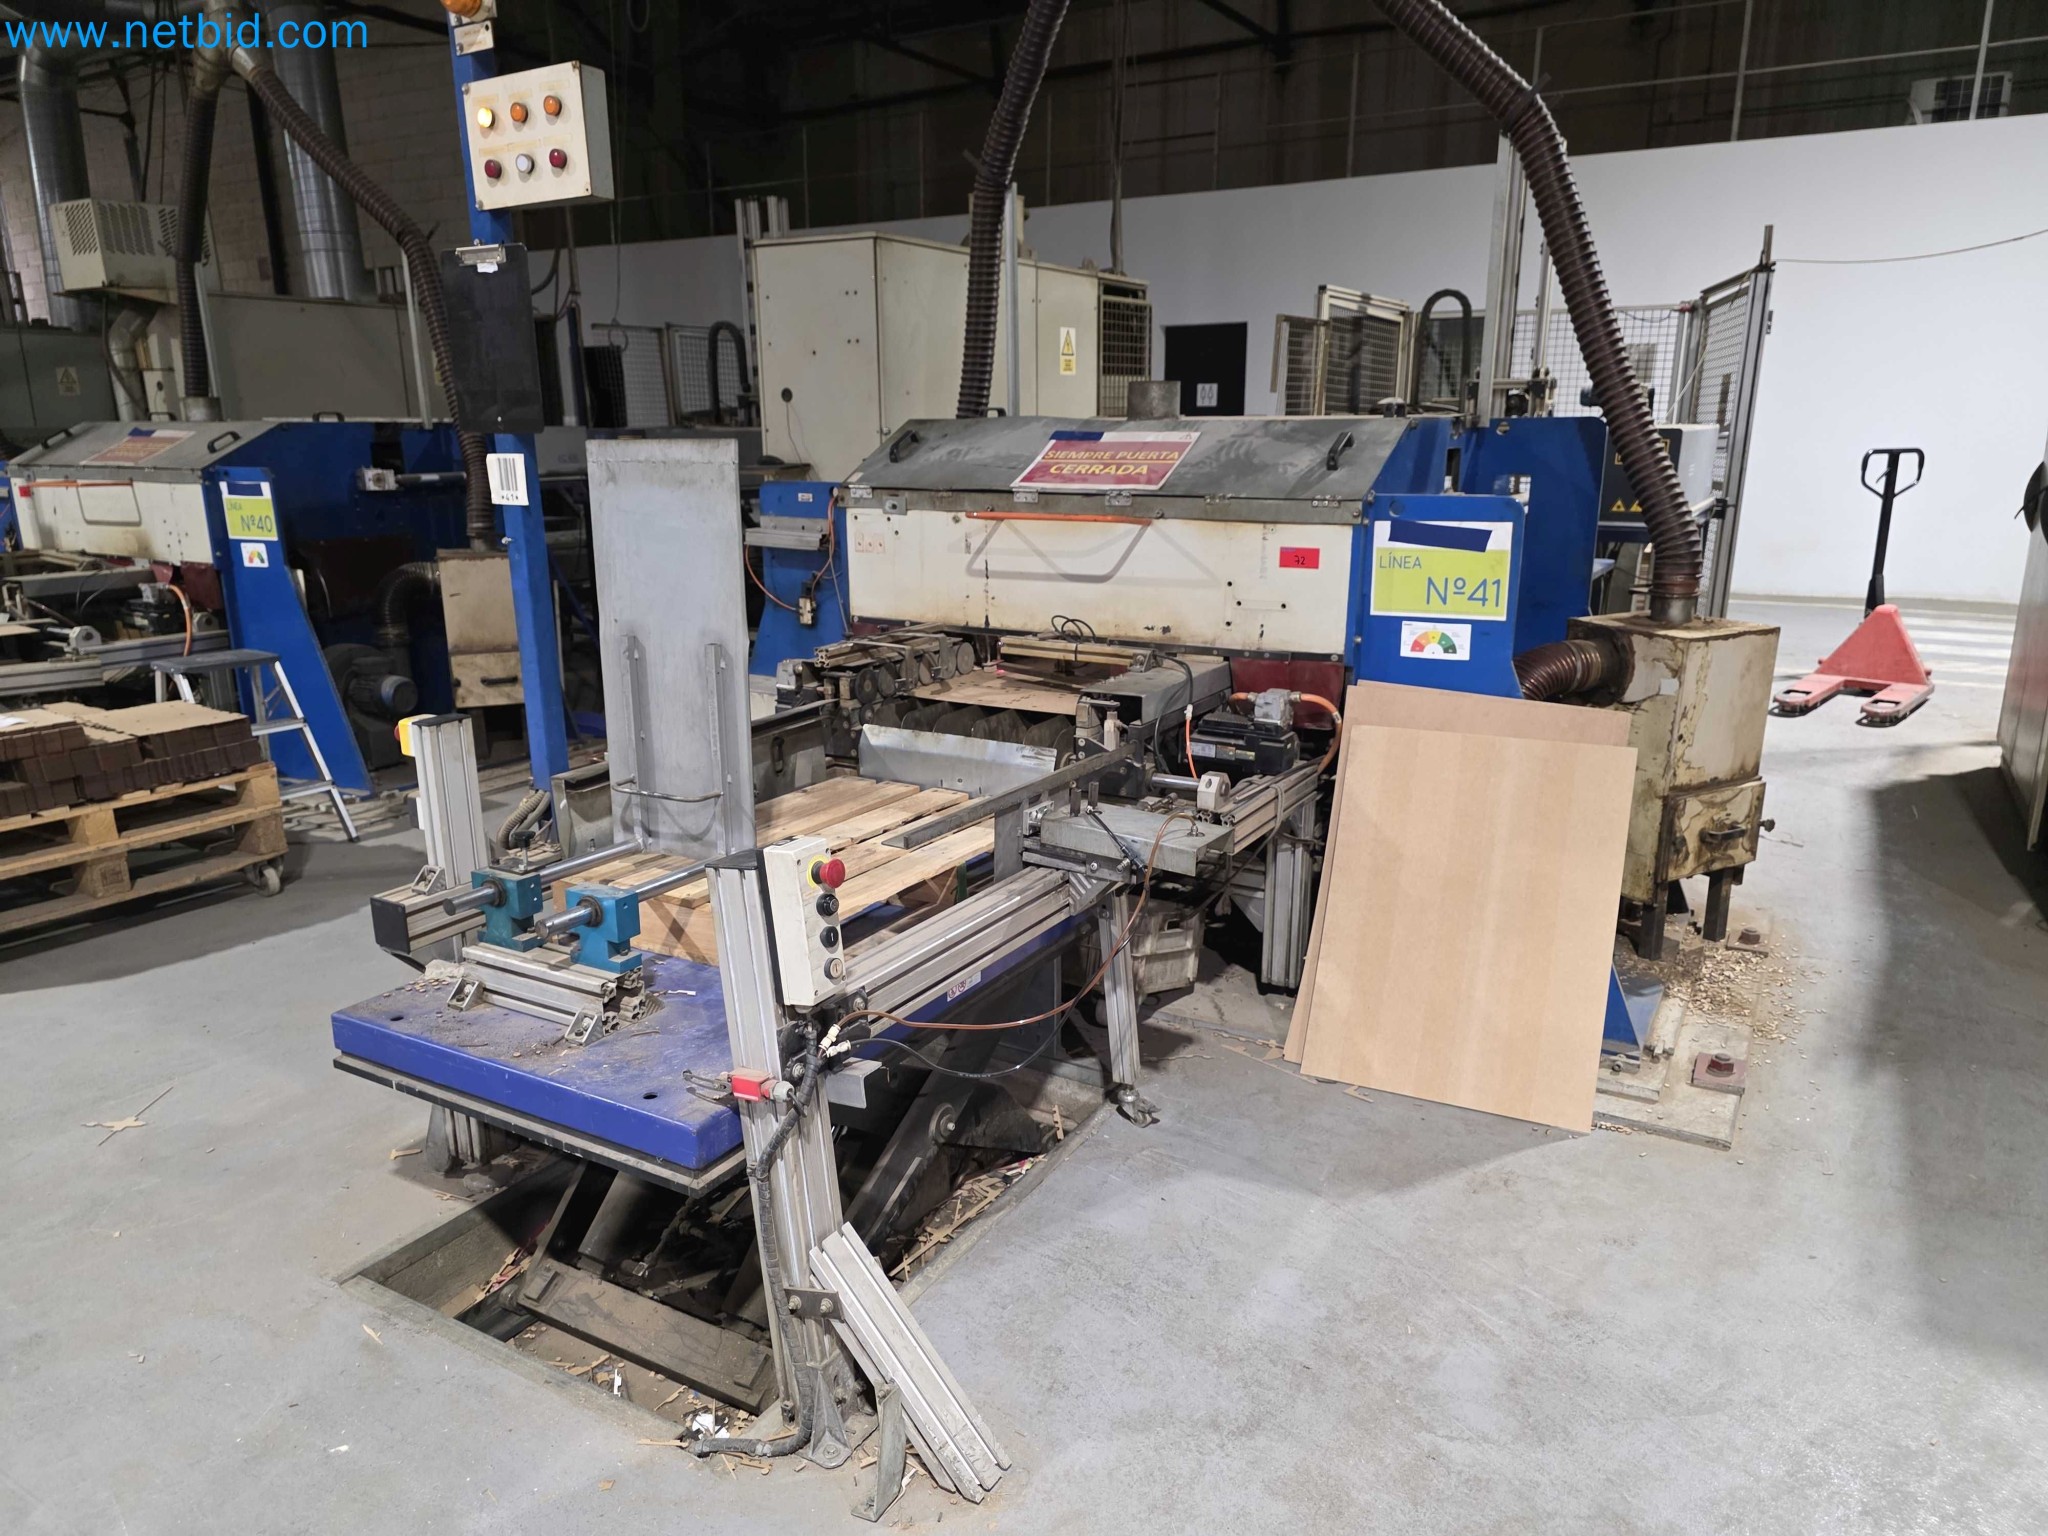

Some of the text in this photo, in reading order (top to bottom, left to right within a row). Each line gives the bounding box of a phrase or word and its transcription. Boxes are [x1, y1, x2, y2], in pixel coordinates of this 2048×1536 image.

[1045, 450, 1178, 460] SIEMPRE PUERTA
[1050, 464, 1148, 475] CERRADA
[1294, 555, 1306, 566] 72
[1379, 552, 1422, 569] LÍNEA
[1426, 577, 1501, 607] Nº41
